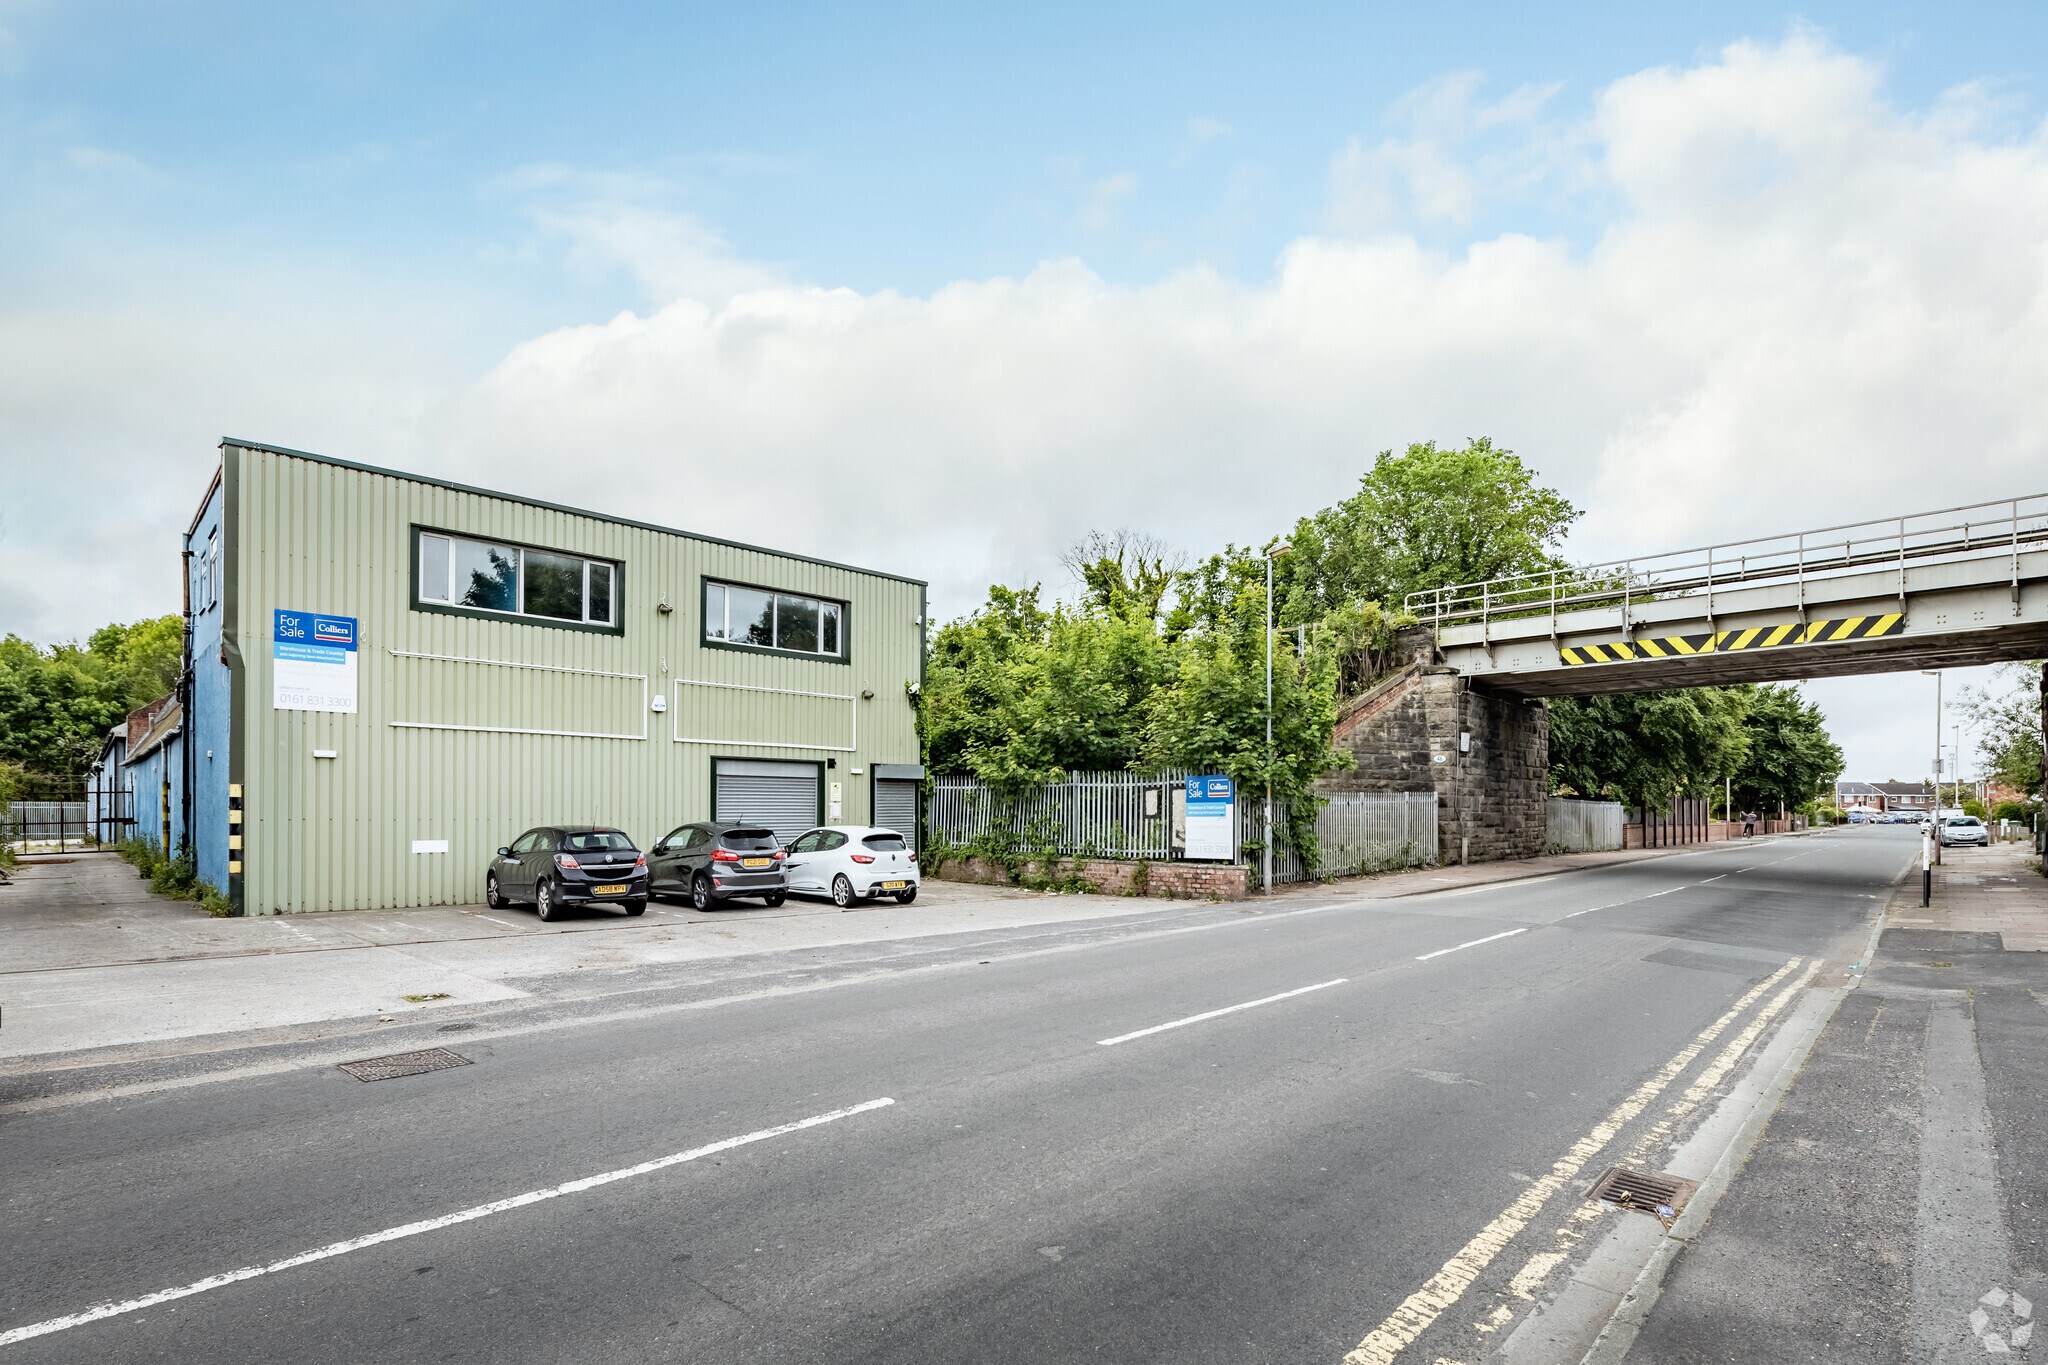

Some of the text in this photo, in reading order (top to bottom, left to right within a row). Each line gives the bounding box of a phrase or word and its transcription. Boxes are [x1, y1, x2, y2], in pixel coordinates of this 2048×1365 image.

[280, 614, 300, 627] For
[280, 625, 305, 638] Sale
[318, 623, 349, 635] Colliers
[280, 693, 352, 707] 0161 831 3300
[1189, 780, 1200, 789] For
[1188, 789, 1203, 798] Sale
